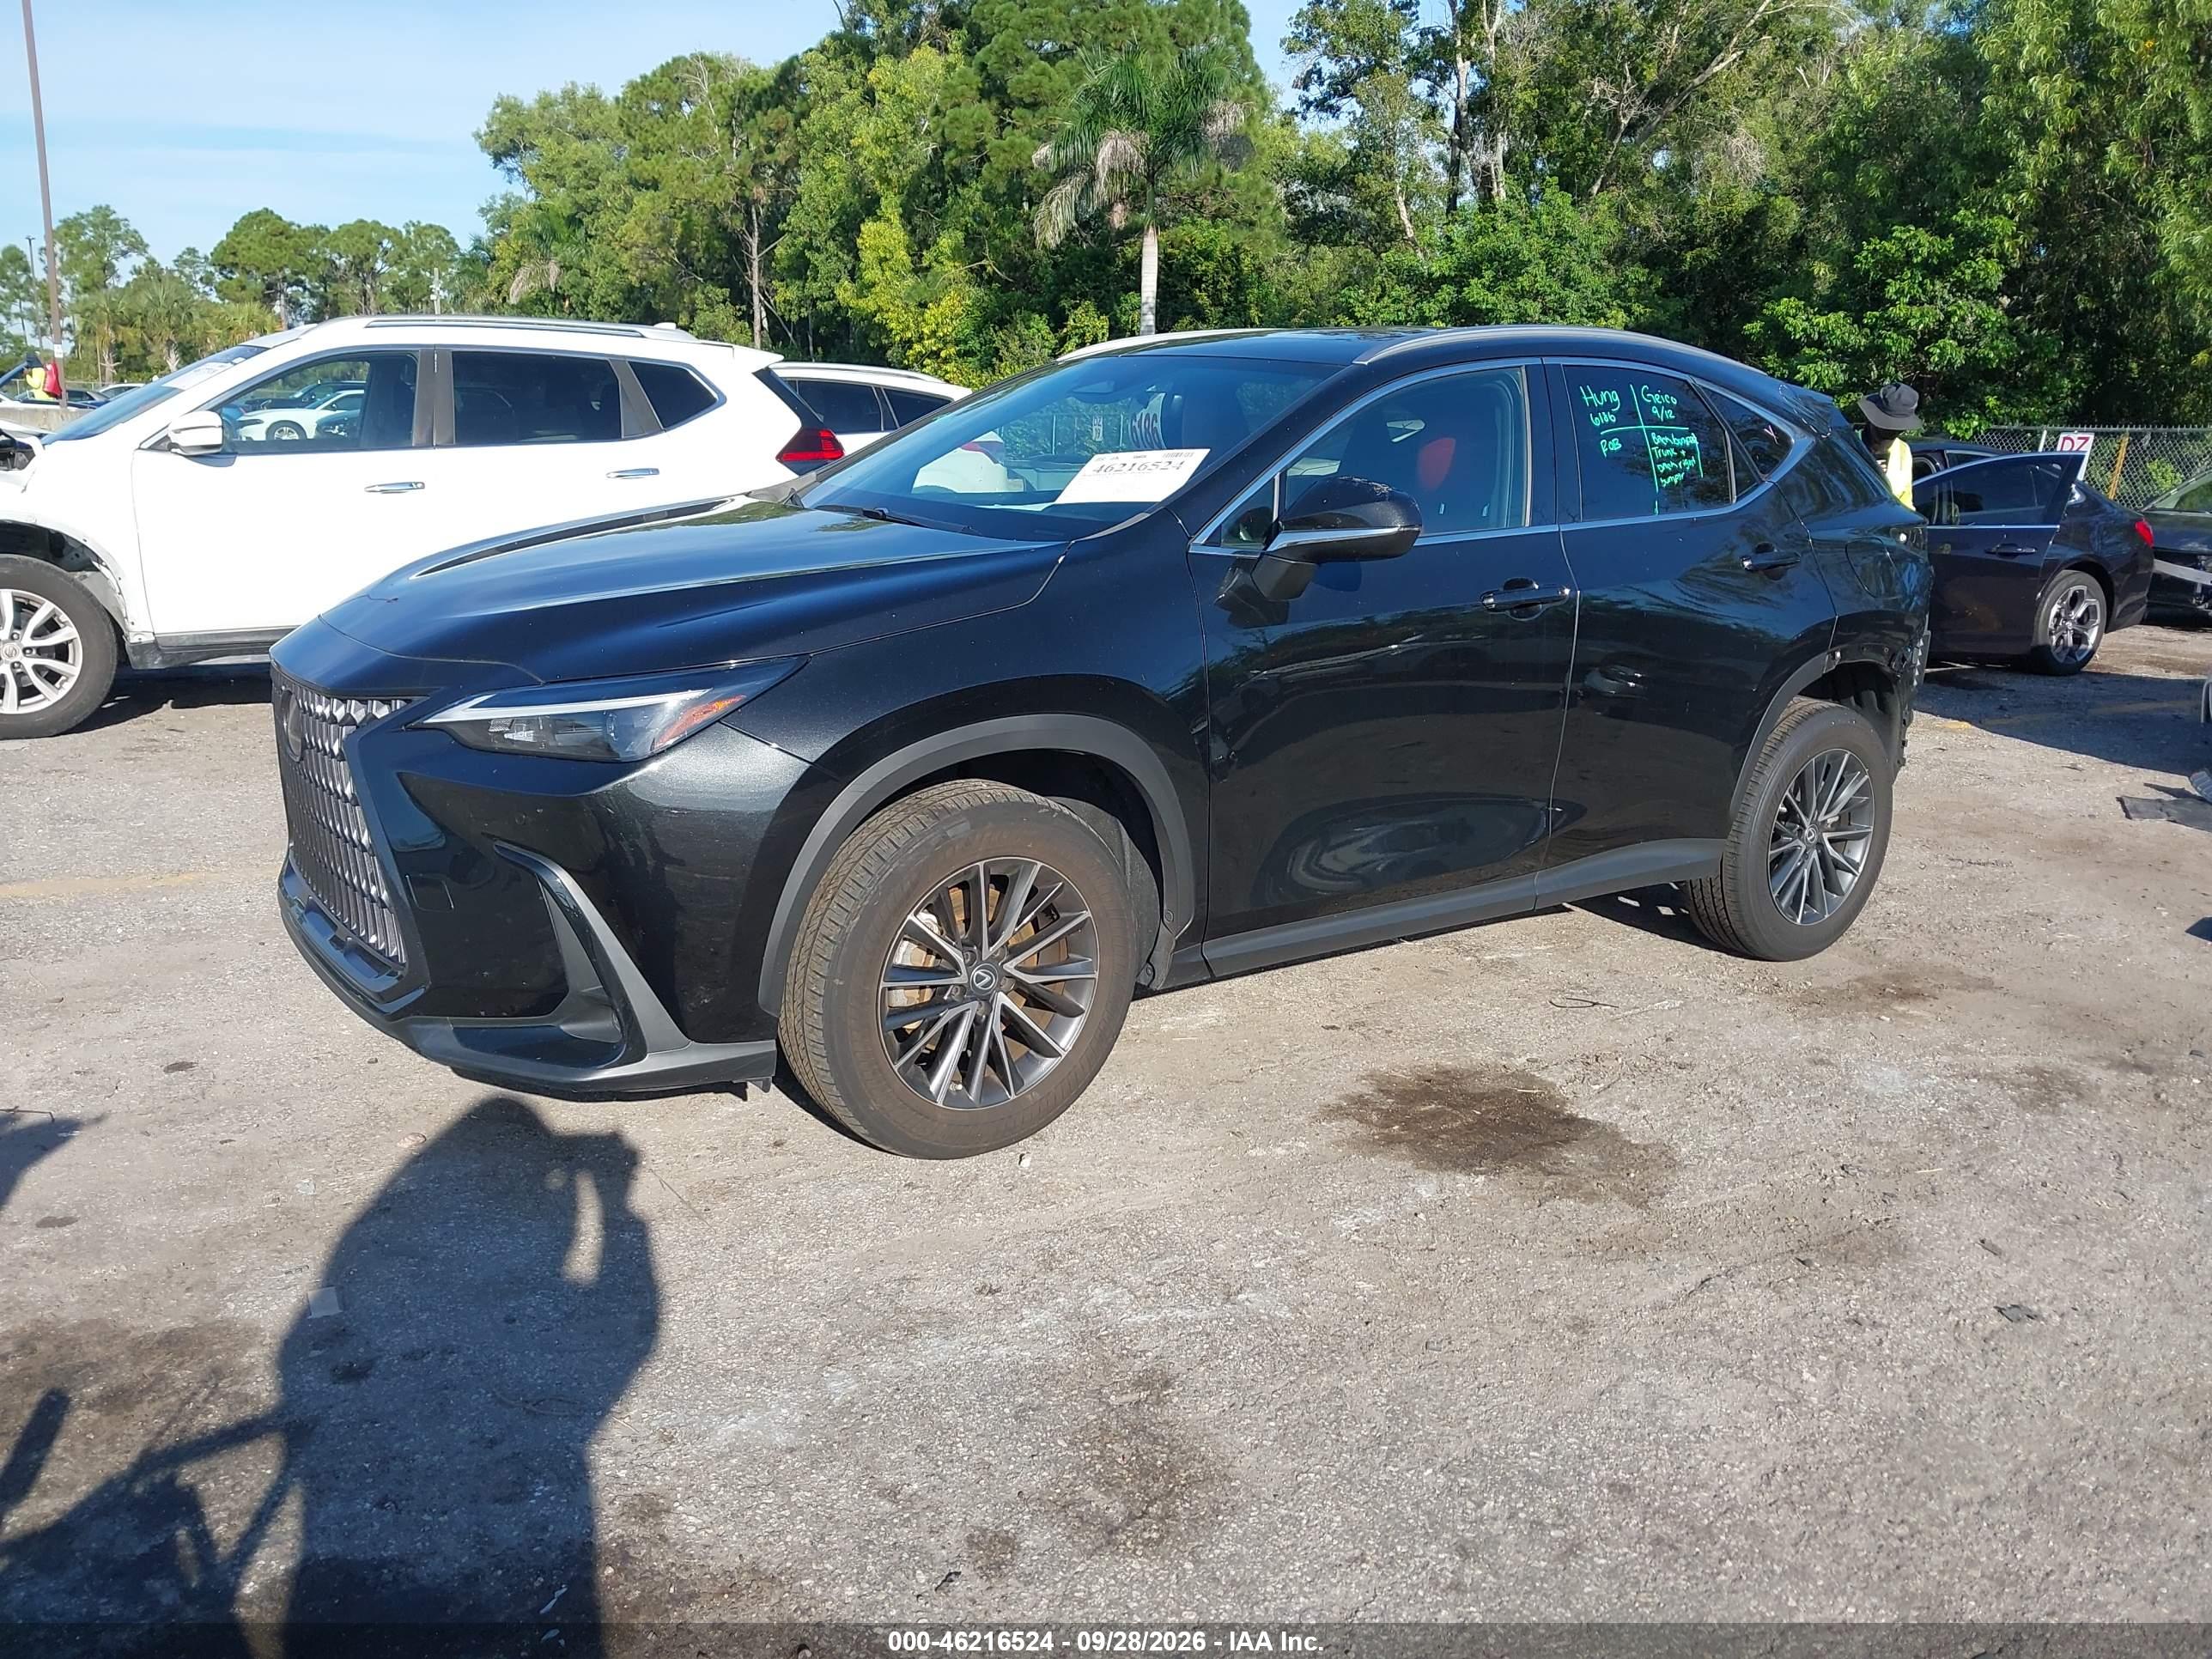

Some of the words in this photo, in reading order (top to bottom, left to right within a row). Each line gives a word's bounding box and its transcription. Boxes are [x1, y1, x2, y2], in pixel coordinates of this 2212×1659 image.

[1579, 385, 1621, 411] Hung
[1641, 385, 1677, 405] Geico
[1589, 411, 1616, 427] 6186
[1651, 405, 1676, 422] 9/12
[1092, 459, 1186, 474] 46216524
